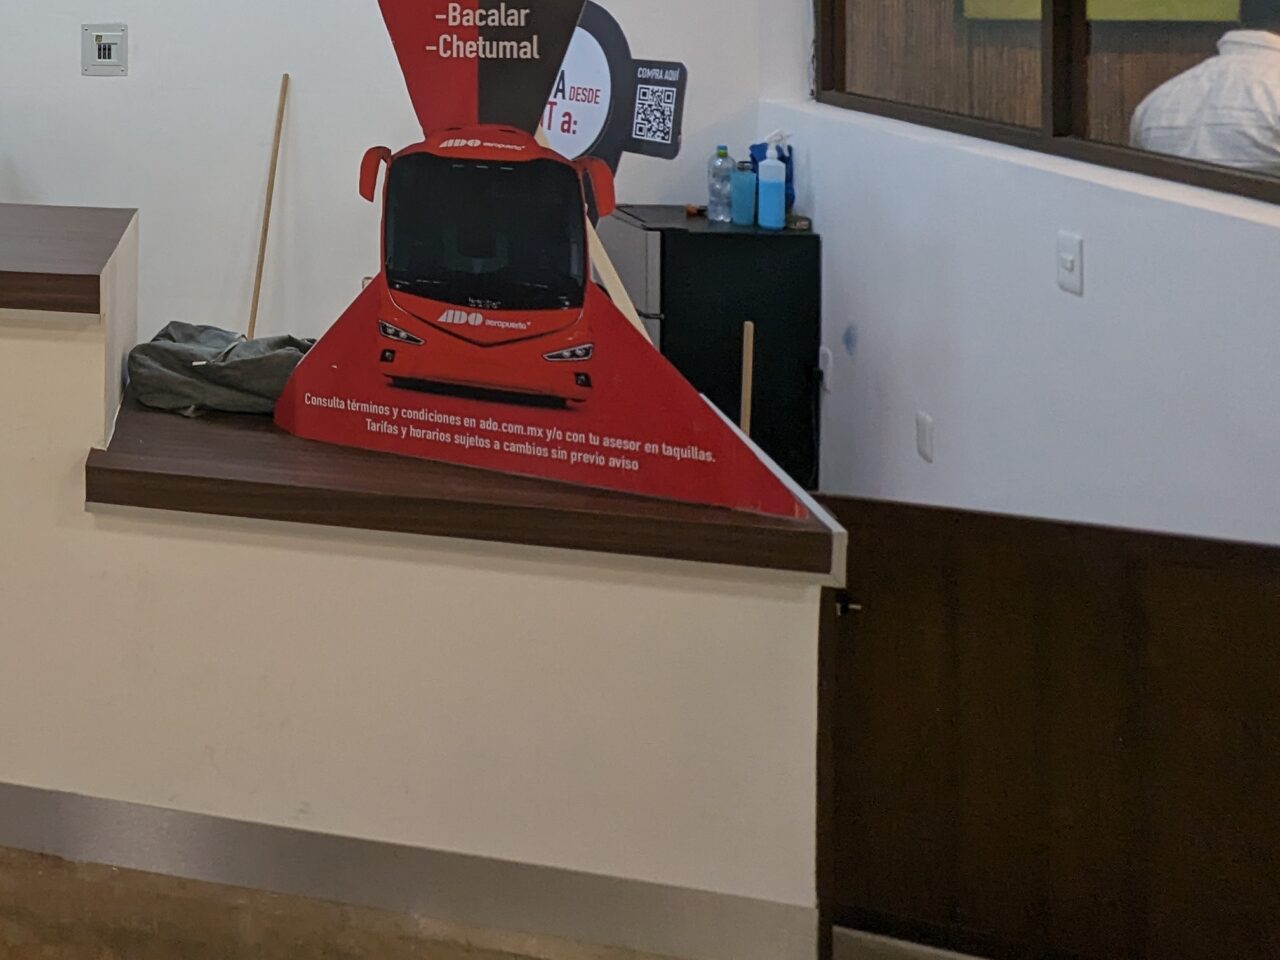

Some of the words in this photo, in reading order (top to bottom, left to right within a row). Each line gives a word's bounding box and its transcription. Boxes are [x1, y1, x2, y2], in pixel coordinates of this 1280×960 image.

[435, 2, 531, 27] -Bacalar
[425, 34, 540, 59] -Chetumal
[568, 85, 601, 105] DESDE
[560, 111, 578, 135] a:
[439, 138, 481, 148] ADO
[437, 309, 483, 326] ADO
[304, 392, 345, 410] Consulta
[347, 399, 390, 416] términos
[392, 407, 399, 418] y
[401, 407, 461, 426] condiciones
[463, 417, 476, 428] en
[479, 417, 543, 438] ado.com.mx
[546, 427, 562, 441] y/o
[566, 429, 585, 443] con
[589, 431, 599, 446] tu
[602, 435, 640, 452] asesor
[644, 442, 658, 455] en
[661, 443, 716, 463] taquillas.
[366, 418, 399, 435] Tarifas
[401, 427, 407, 439] y
[409, 425, 452, 443] horarios
[454, 433, 491, 449] sujetos
[494, 440, 500, 450] a
[503, 441, 549, 457] cambios
[551, 445, 567, 460] sin
[570, 448, 605, 465] previo
[608, 454, 639, 471] aviso
